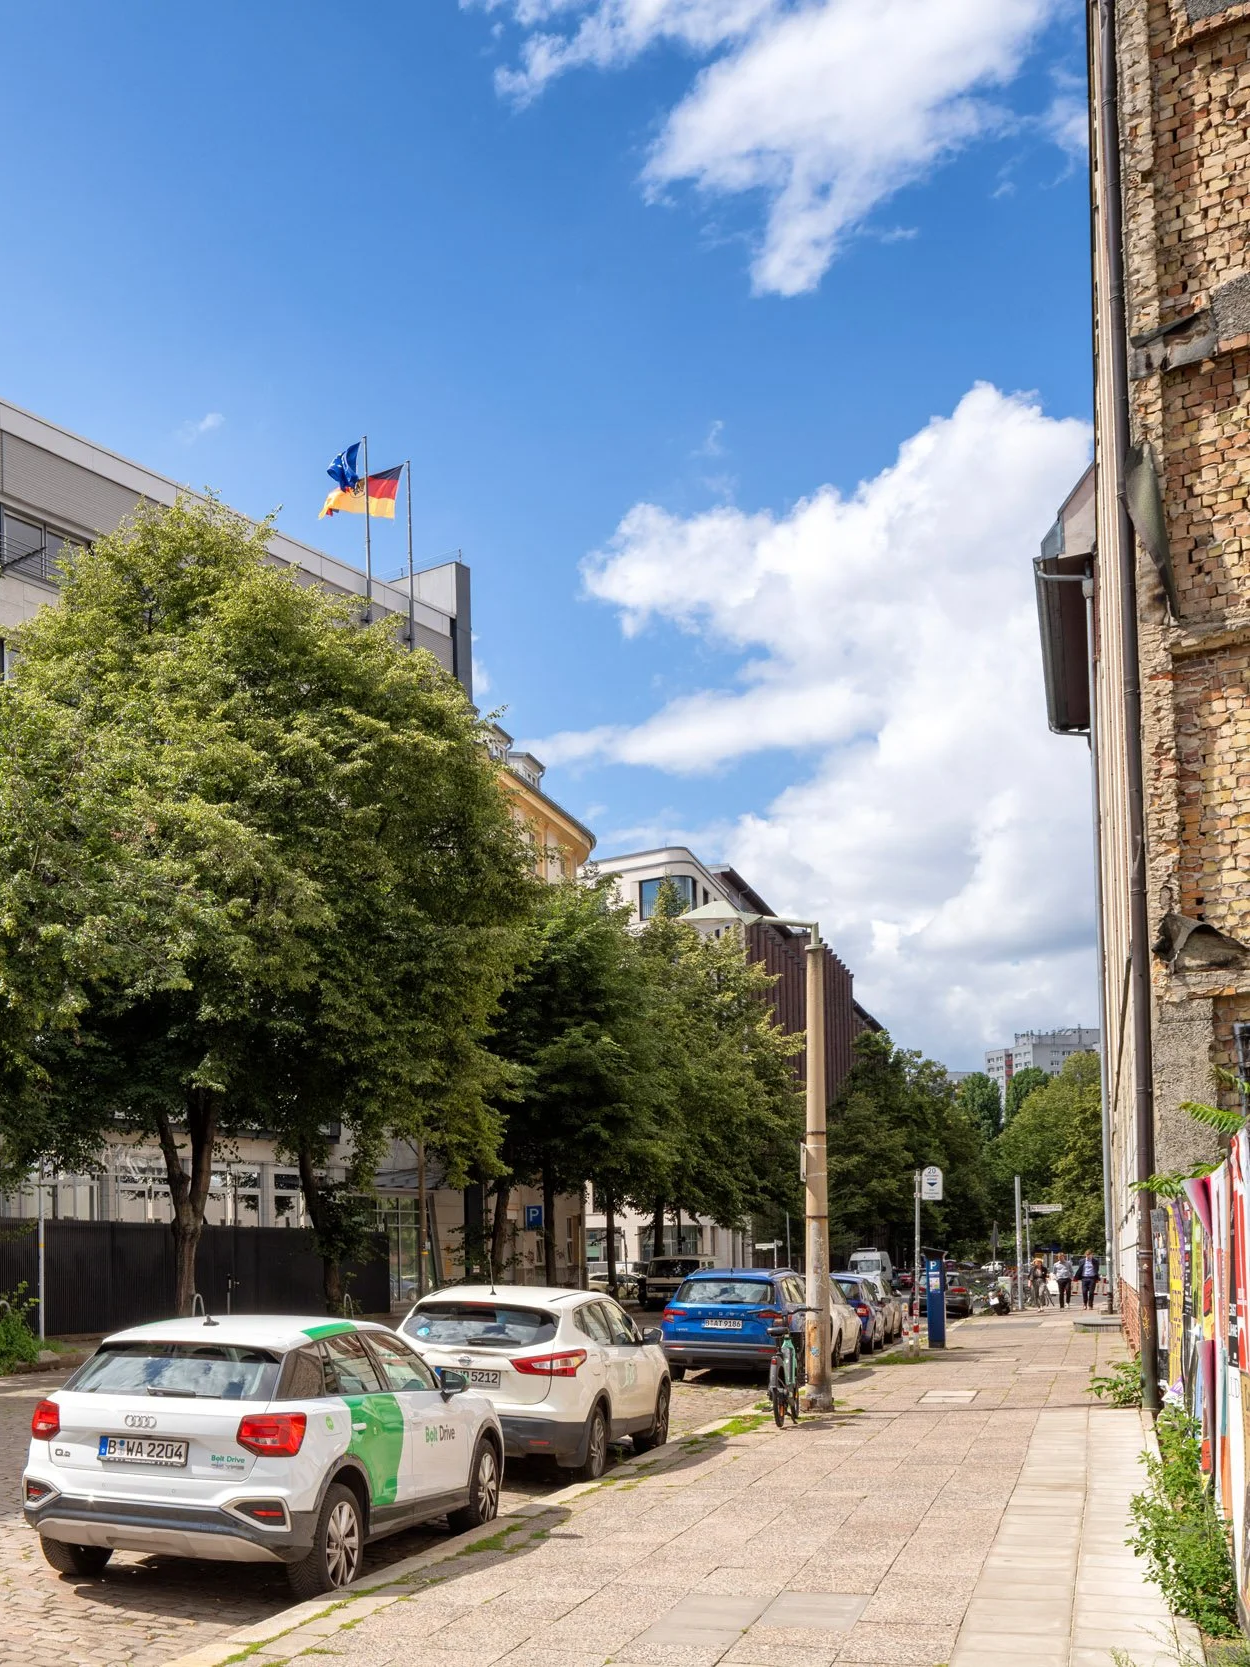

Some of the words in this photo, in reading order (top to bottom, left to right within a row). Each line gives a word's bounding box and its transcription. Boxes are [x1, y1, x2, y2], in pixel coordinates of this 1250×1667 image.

[927, 1167, 937, 1175] 20
[530, 1208, 540, 1222] P
[930, 1261, 937, 1270] P
[470, 1371, 499, 1384] 5212
[425, 1426, 438, 1443] Bolt
[439, 1424, 456, 1441] Drive
[108, 1441, 116, 1454] B
[126, 1442, 143, 1457] WA
[146, 1443, 183, 1460] 2204
[211, 1454, 225, 1462] Bolt
[226, 1455, 246, 1464] Drive
